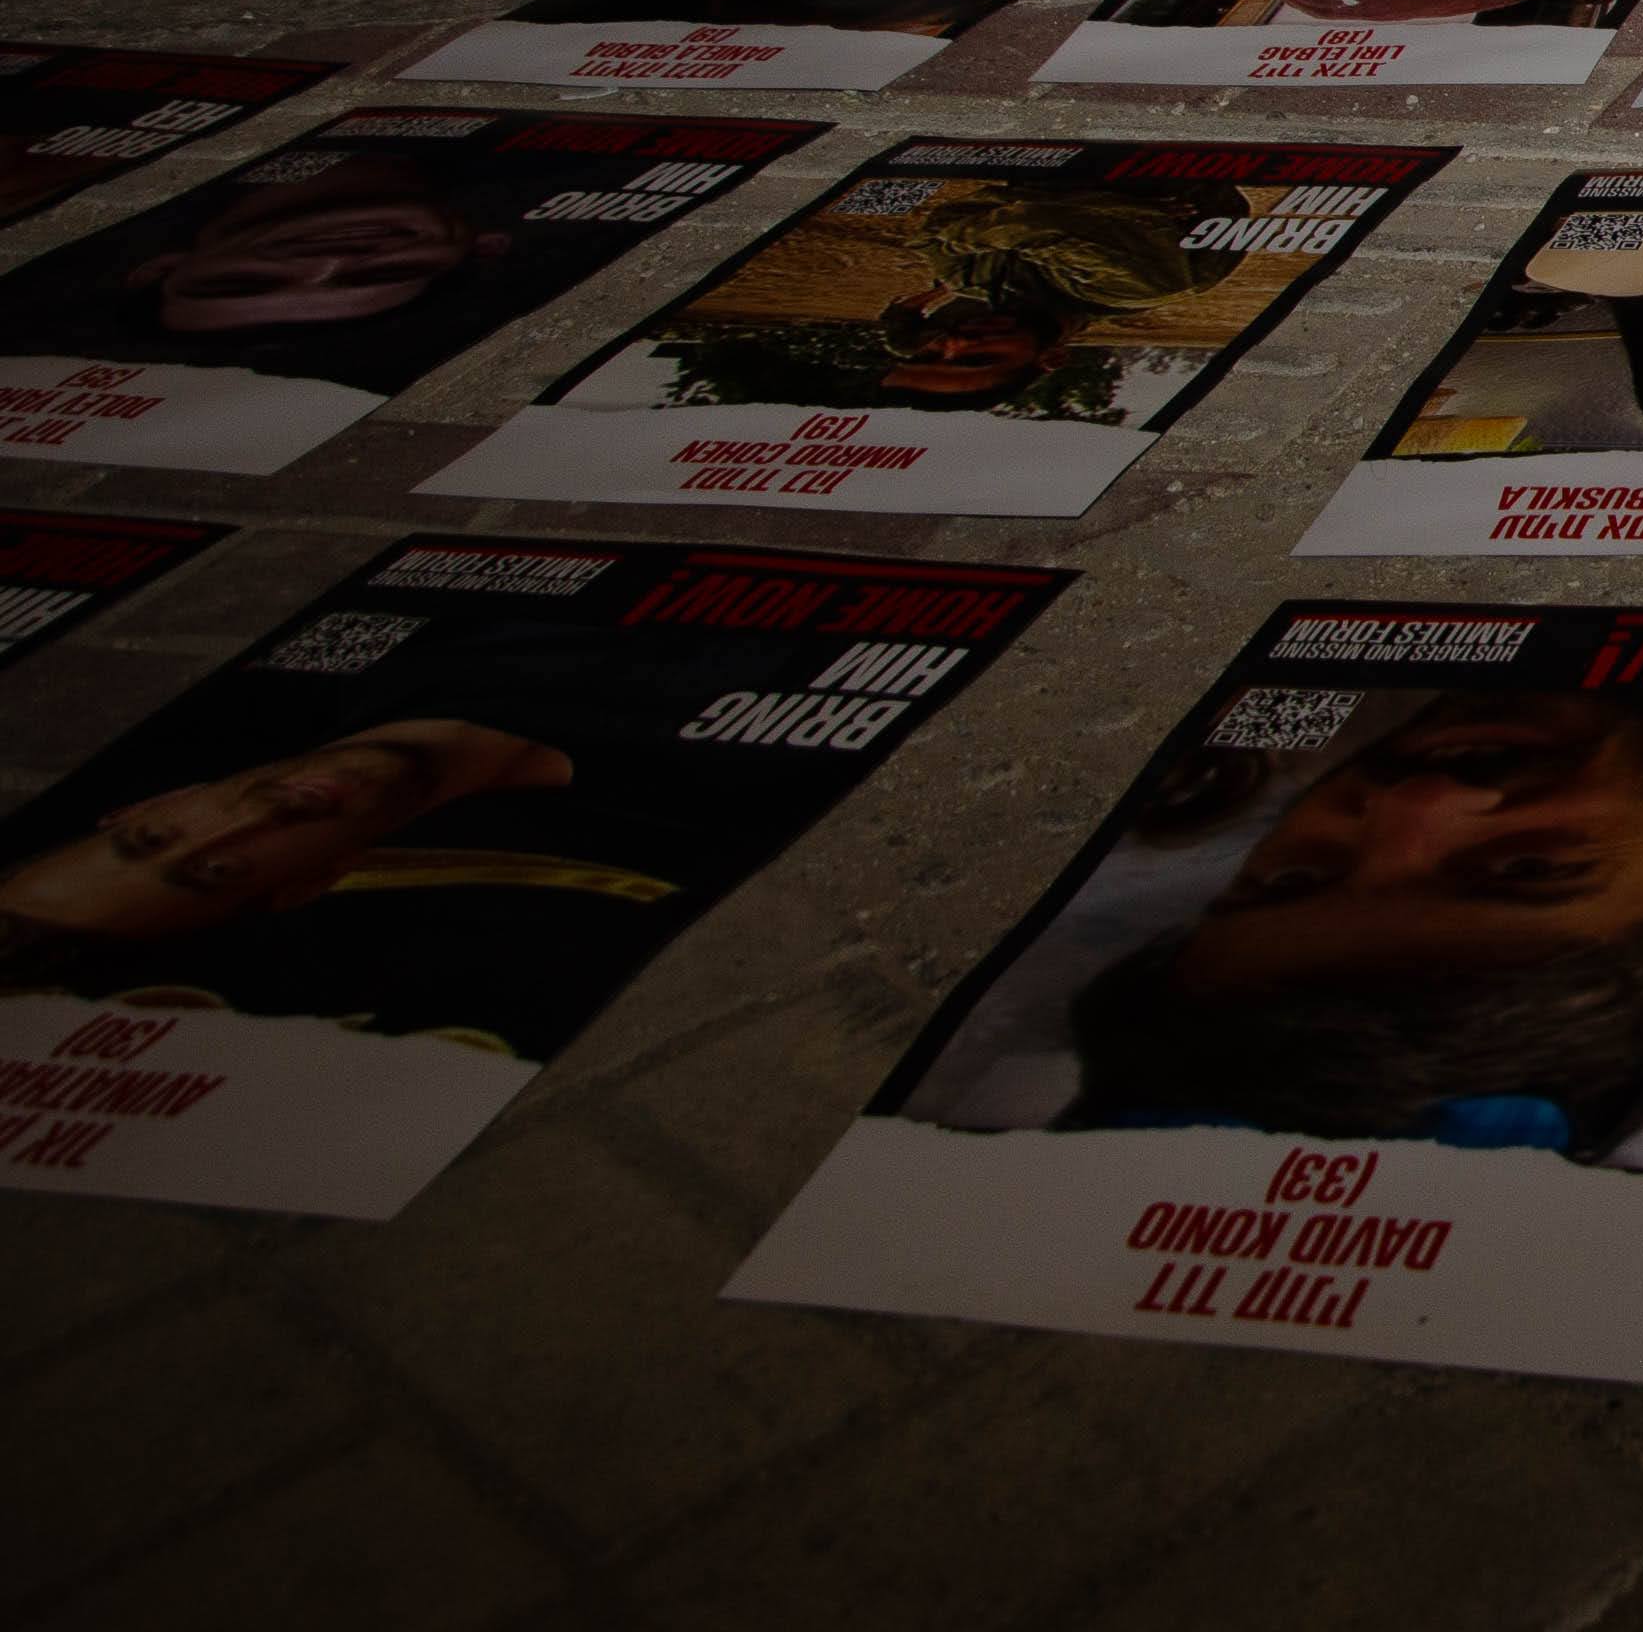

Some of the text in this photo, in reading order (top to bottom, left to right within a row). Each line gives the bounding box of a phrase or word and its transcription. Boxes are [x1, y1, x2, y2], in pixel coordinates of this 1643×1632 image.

[585, 40, 786, 61] DANIELA GILBOA
[1257, 44, 1405, 61] LIRI ELBAG
[1318, 29, 1376, 46] (18)
[624, 160, 741, 193] HIM
[522, 190, 694, 221] BRING
[1274, 185, 1389, 217] HIM
[1179, 217, 1355, 254] BRING
[790, 412, 869, 439] (19)
[670, 439, 928, 469] NIMROD COHEN
[1490, 514, 1594, 539] עמית
[809, 641, 969, 694] HIM
[677, 690, 912, 751] BRING
[50, 1016, 178, 1060] (30)
[1264, 1150, 1378, 1205] (33)
[1127, 1200, 1452, 1270] DAVID KONIO
[1135, 1262, 1369, 1328] דוד קוניו
